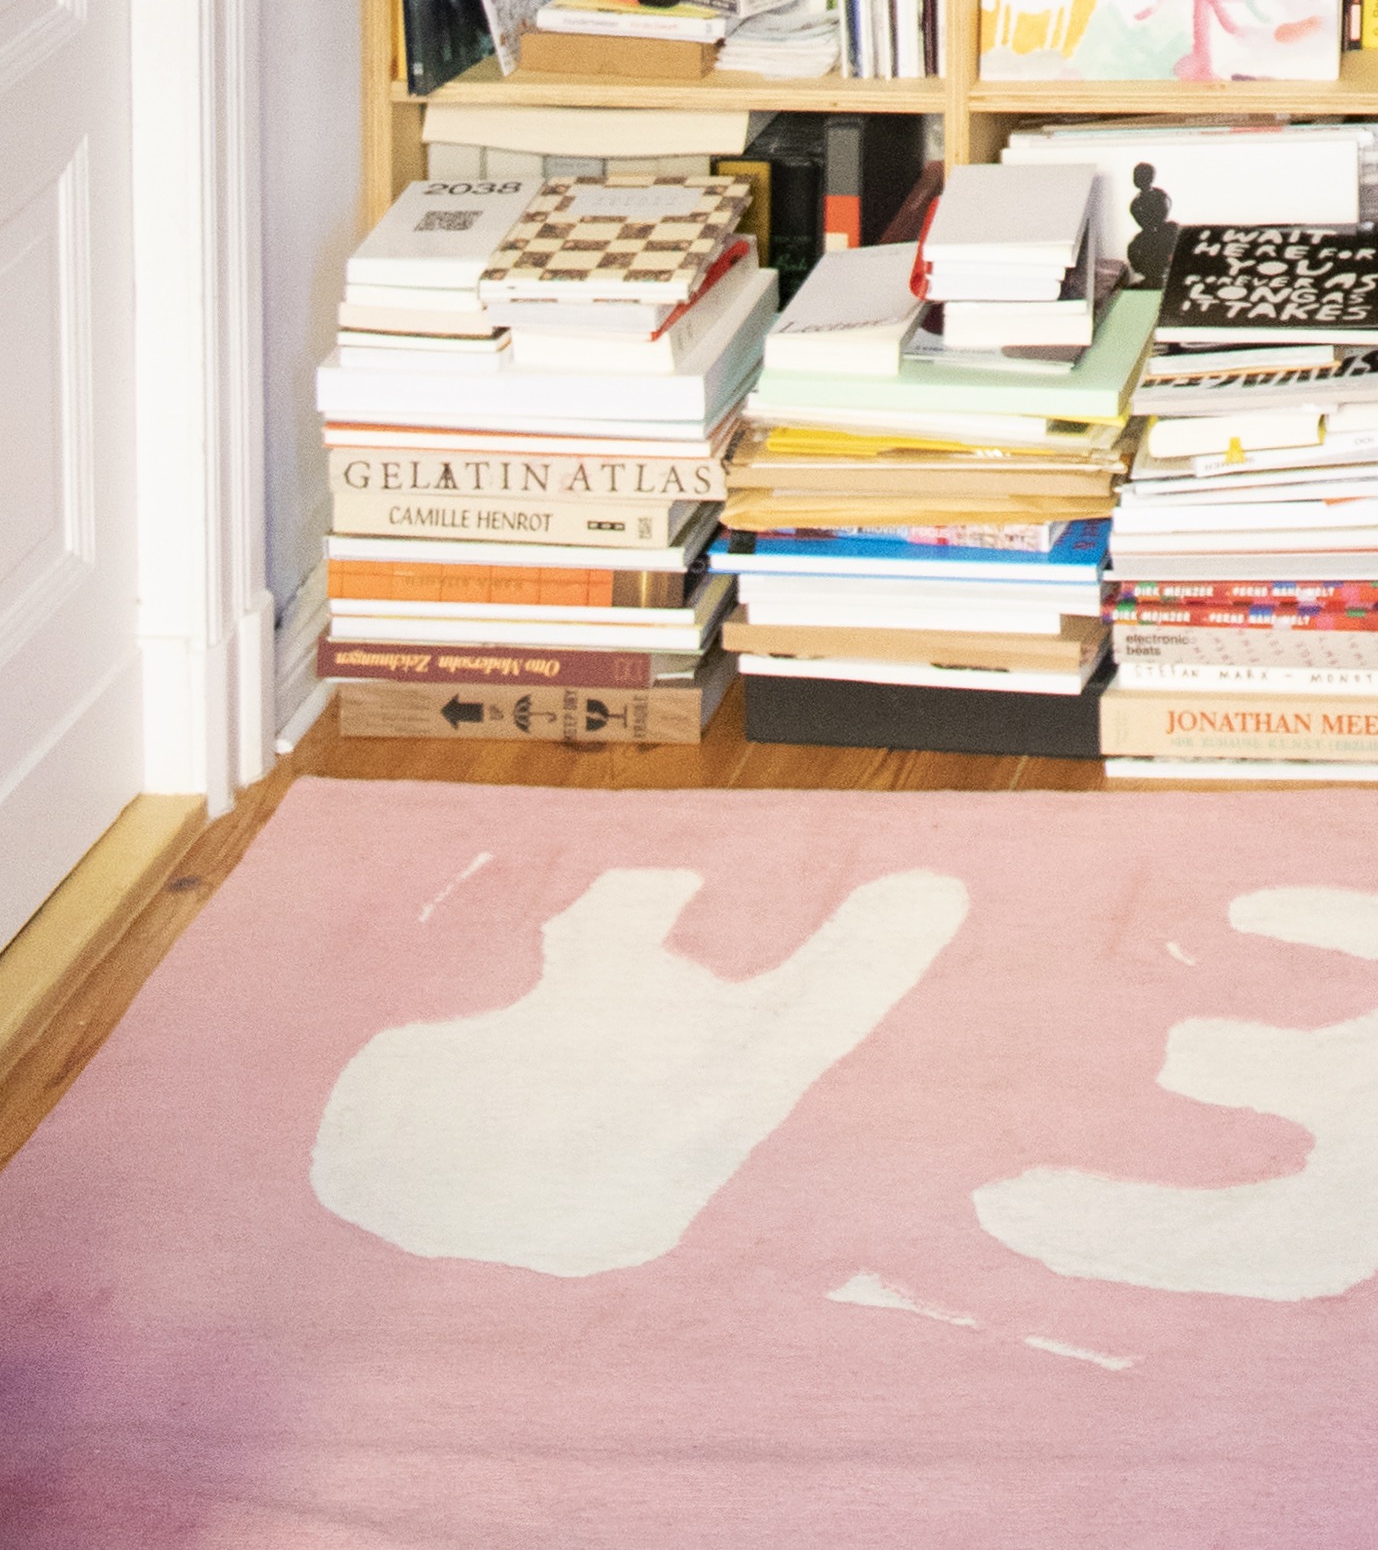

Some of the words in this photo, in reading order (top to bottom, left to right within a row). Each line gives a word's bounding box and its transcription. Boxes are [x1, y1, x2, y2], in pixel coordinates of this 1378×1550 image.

[423, 180, 523, 196] 2038
[1222, 229, 1338, 245] WAIT
[1193, 242, 1310, 260] HERE
[1318, 247, 1376, 260] FOR
[1226, 257, 1334, 277] YOU
[1189, 283, 1319, 304] LONG
[1321, 291, 1366, 304] AS
[1182, 298, 1220, 312] IT
[1224, 301, 1373, 321] TAKES
[343, 459, 552, 495] GELATIN
[567, 461, 713, 496] ATLAS
[388, 506, 471, 531] CAMILLE
[475, 509, 553, 534] HENROT
[1165, 709, 1312, 735] JONATHAN
